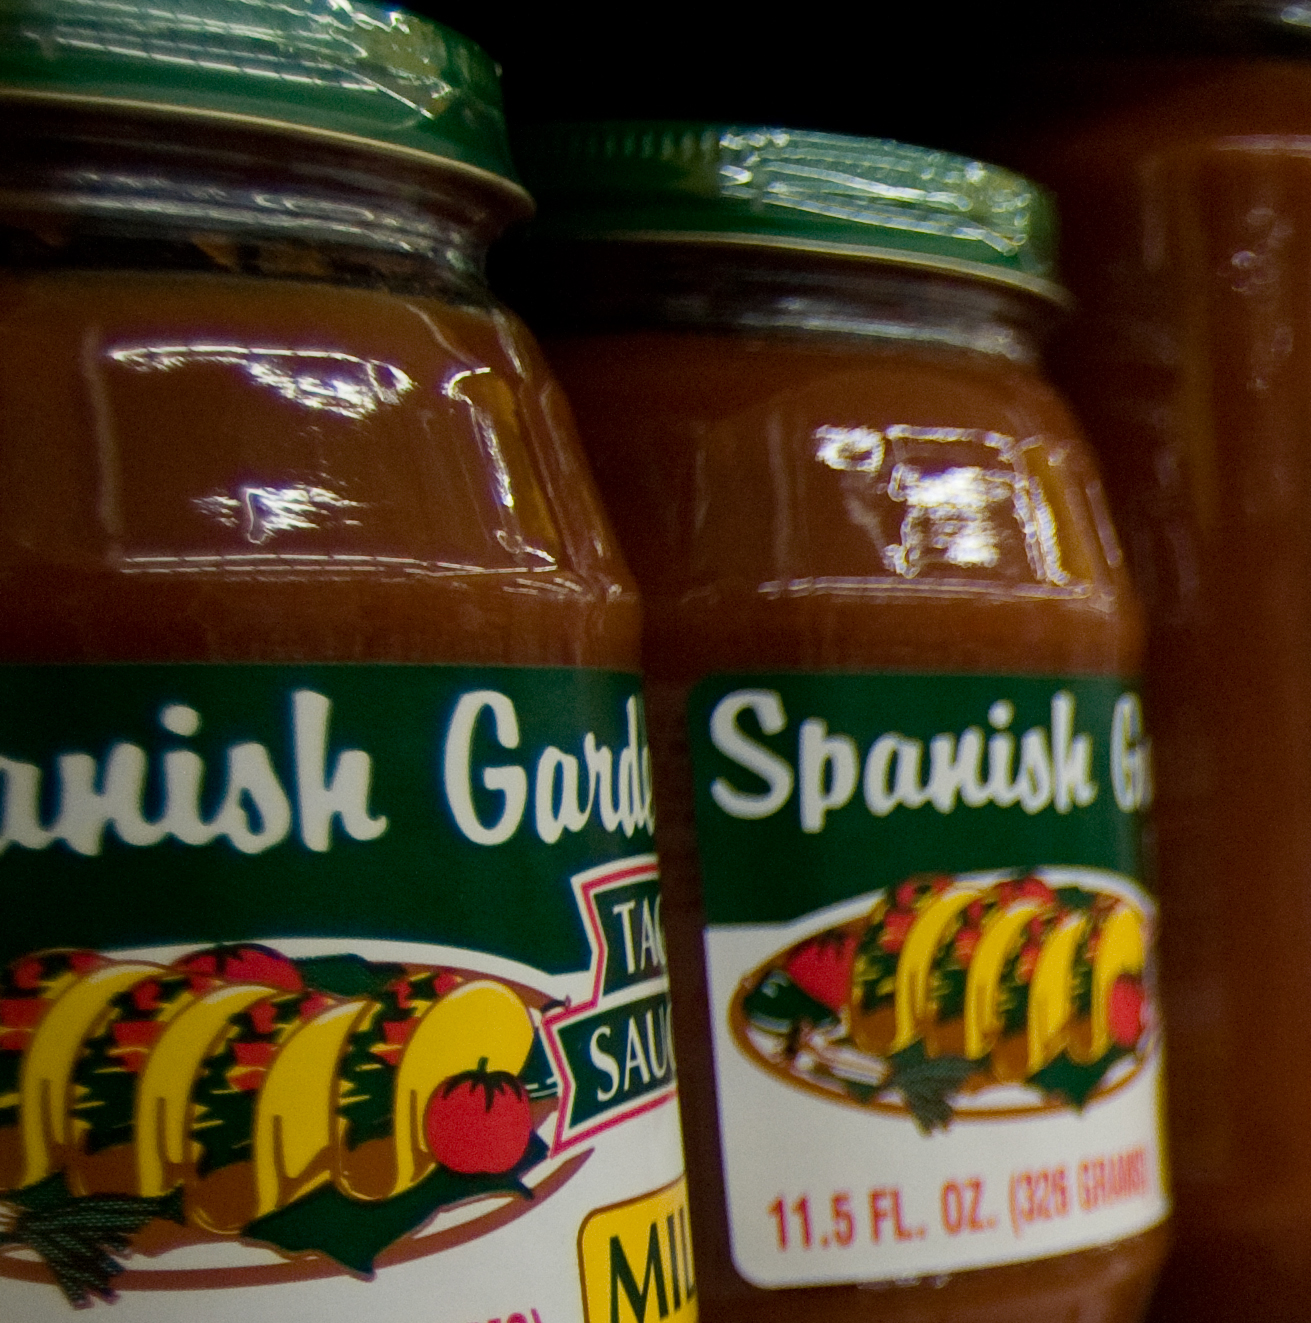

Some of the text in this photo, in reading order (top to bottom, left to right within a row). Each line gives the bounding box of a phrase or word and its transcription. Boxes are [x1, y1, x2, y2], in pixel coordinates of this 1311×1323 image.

[709, 689, 1100, 834] Spanish
[767, 1191, 857, 1252] 11.5
[868, 1184, 928, 1244] FL.
[940, 1177, 998, 1236] OZ.
